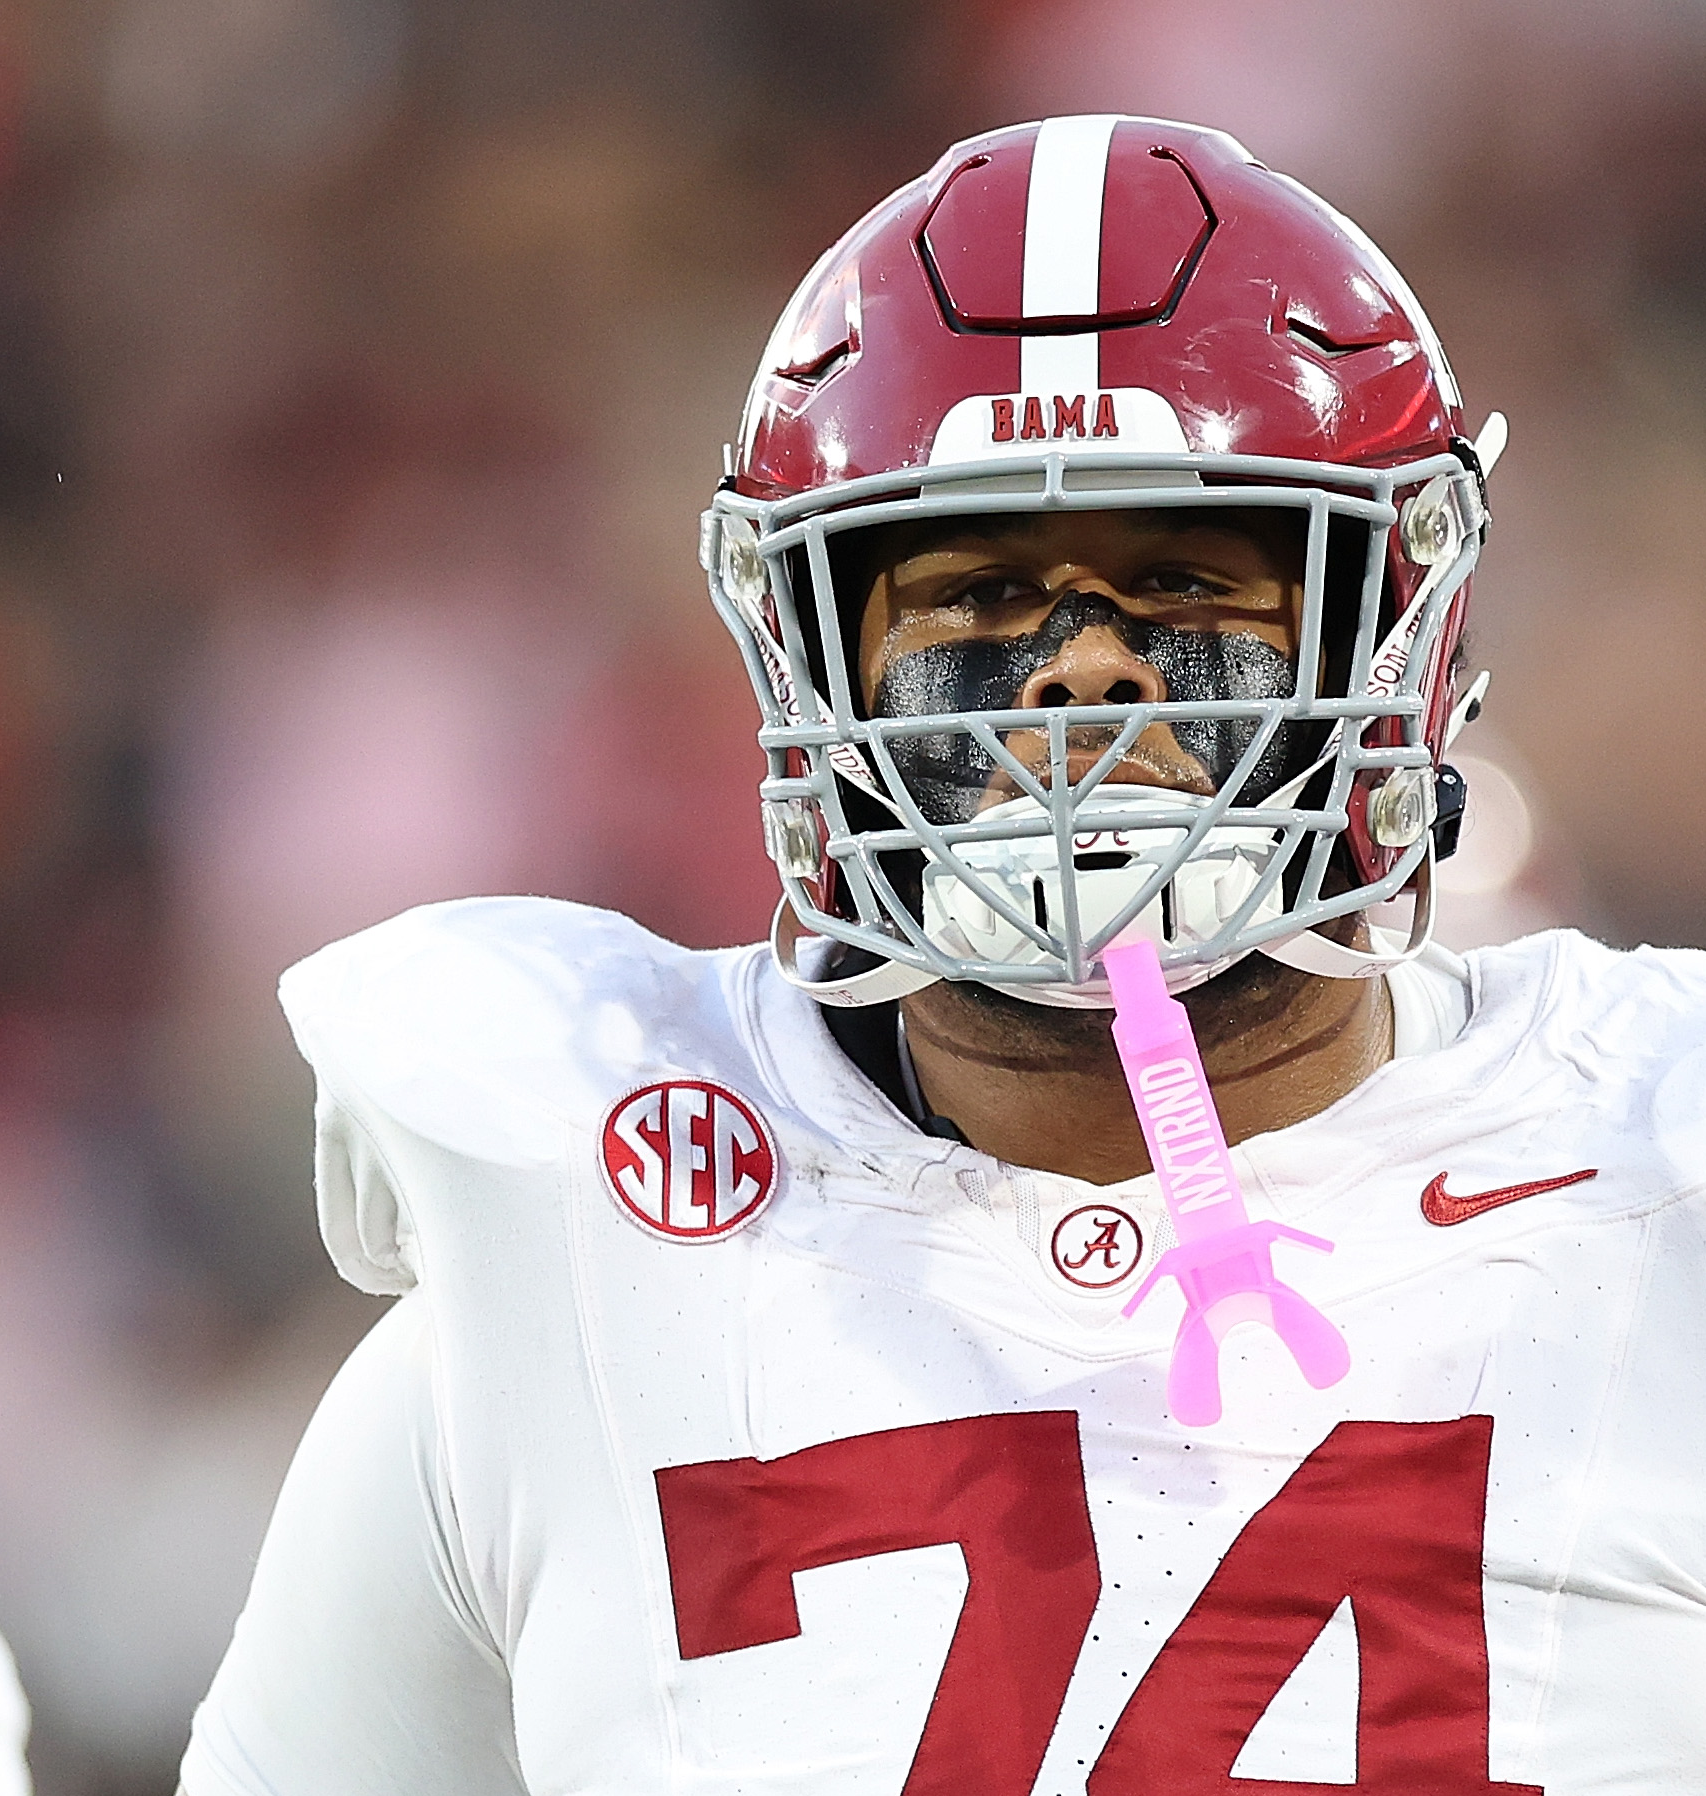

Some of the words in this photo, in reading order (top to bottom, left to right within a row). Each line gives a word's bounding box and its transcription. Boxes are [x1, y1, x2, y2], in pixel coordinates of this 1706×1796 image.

[992, 394, 1119, 442] BAMA
[613, 1087, 762, 1230] SEC
[1138, 1056, 1233, 1216] NXTRND
